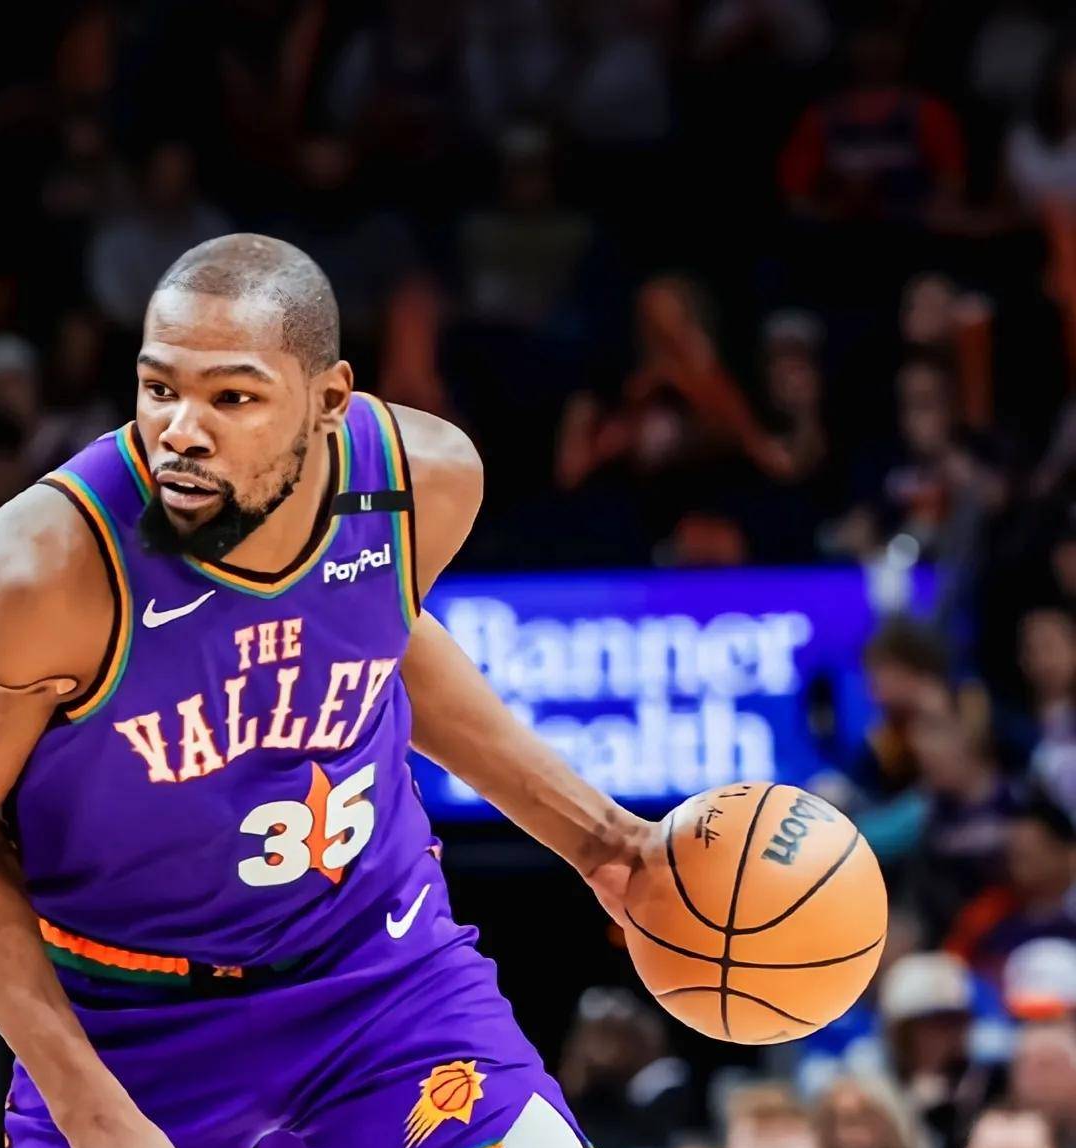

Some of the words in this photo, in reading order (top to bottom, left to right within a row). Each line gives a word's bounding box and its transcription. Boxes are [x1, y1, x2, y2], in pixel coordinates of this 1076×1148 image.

[324, 543, 391, 583] PayPal
[234, 617, 304, 671] THE
[444, 596, 814, 701] Banner
[446, 694, 776, 803] ealth
[237, 762, 376, 887] 35
